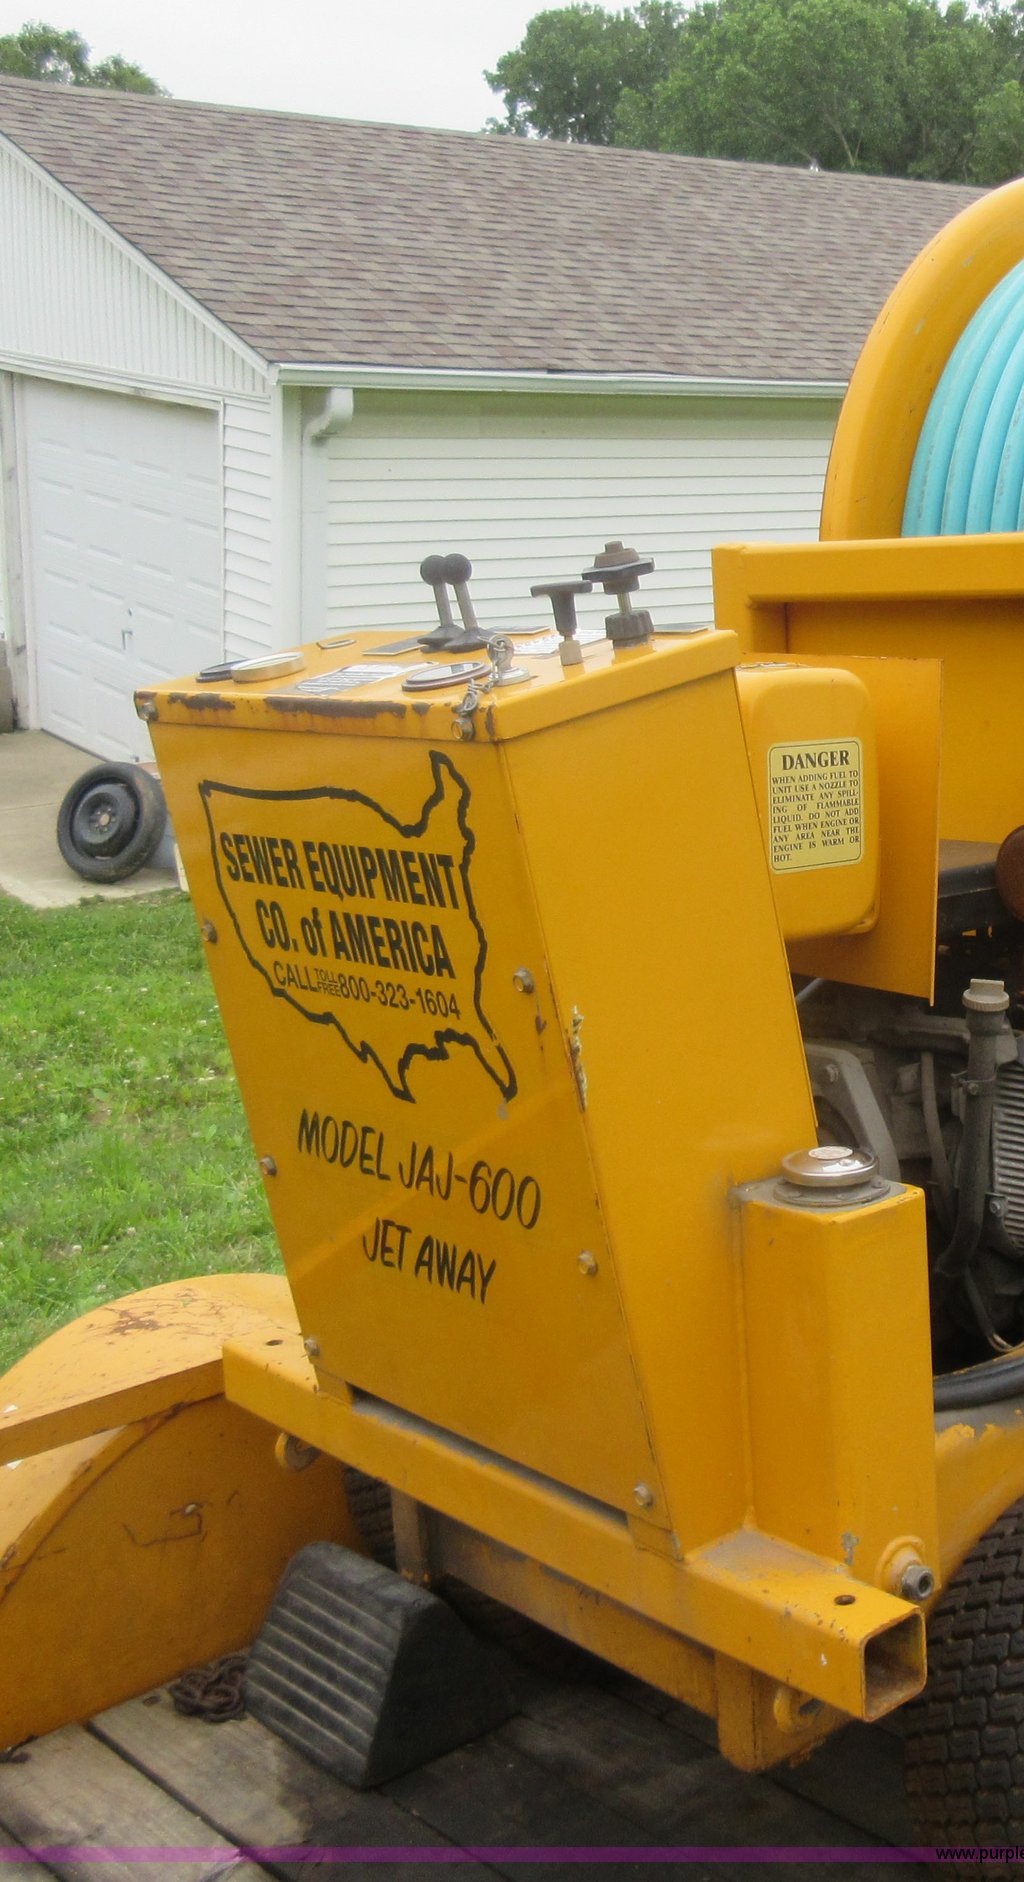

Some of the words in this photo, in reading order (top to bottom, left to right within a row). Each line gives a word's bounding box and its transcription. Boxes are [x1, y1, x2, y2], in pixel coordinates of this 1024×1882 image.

[782, 750, 850, 770] DANGER
[772, 776, 796, 784] WHEN
[799, 774, 827, 782] ADDING
[773, 786, 792, 794] UNIT
[819, 781, 846, 790] NOZZLE
[773, 794, 815, 804] ELIMINATE
[773, 806, 787, 814] ING
[817, 799, 859, 809] FLAMMABLE
[773, 815, 802, 824] LIQUID.
[825, 810, 841, 819] NOT
[845, 808, 859, 816] ADD
[774, 825, 792, 833] FUEL
[795, 822, 818, 831] WHEN
[821, 819, 847, 828] ENGINE
[773, 834, 789, 843] ANY
[796, 832, 815, 840] AREA
[821, 829, 840, 837] NEAR
[774, 844, 802, 853] ENGINE
[774, 853, 792, 862] HOT.
[220, 832, 305, 890] SEWER
[303, 841, 460, 909] EQUIPMENT
[256, 899, 297, 952] CO.
[301, 907, 325, 957] of
[330, 911, 456, 979] AMERICA
[274, 961, 318, 992] CALL
[314, 967, 338, 985] TOLL
[317, 982, 340, 998] FREE
[340, 983, 460, 1019] 800-323-1604
[298, 1108, 391, 1181] MODEL
[399, 1141, 541, 1230] JAJ-600
[363, 1217, 412, 1271] JET
[415, 1235, 496, 1304] AWAY
